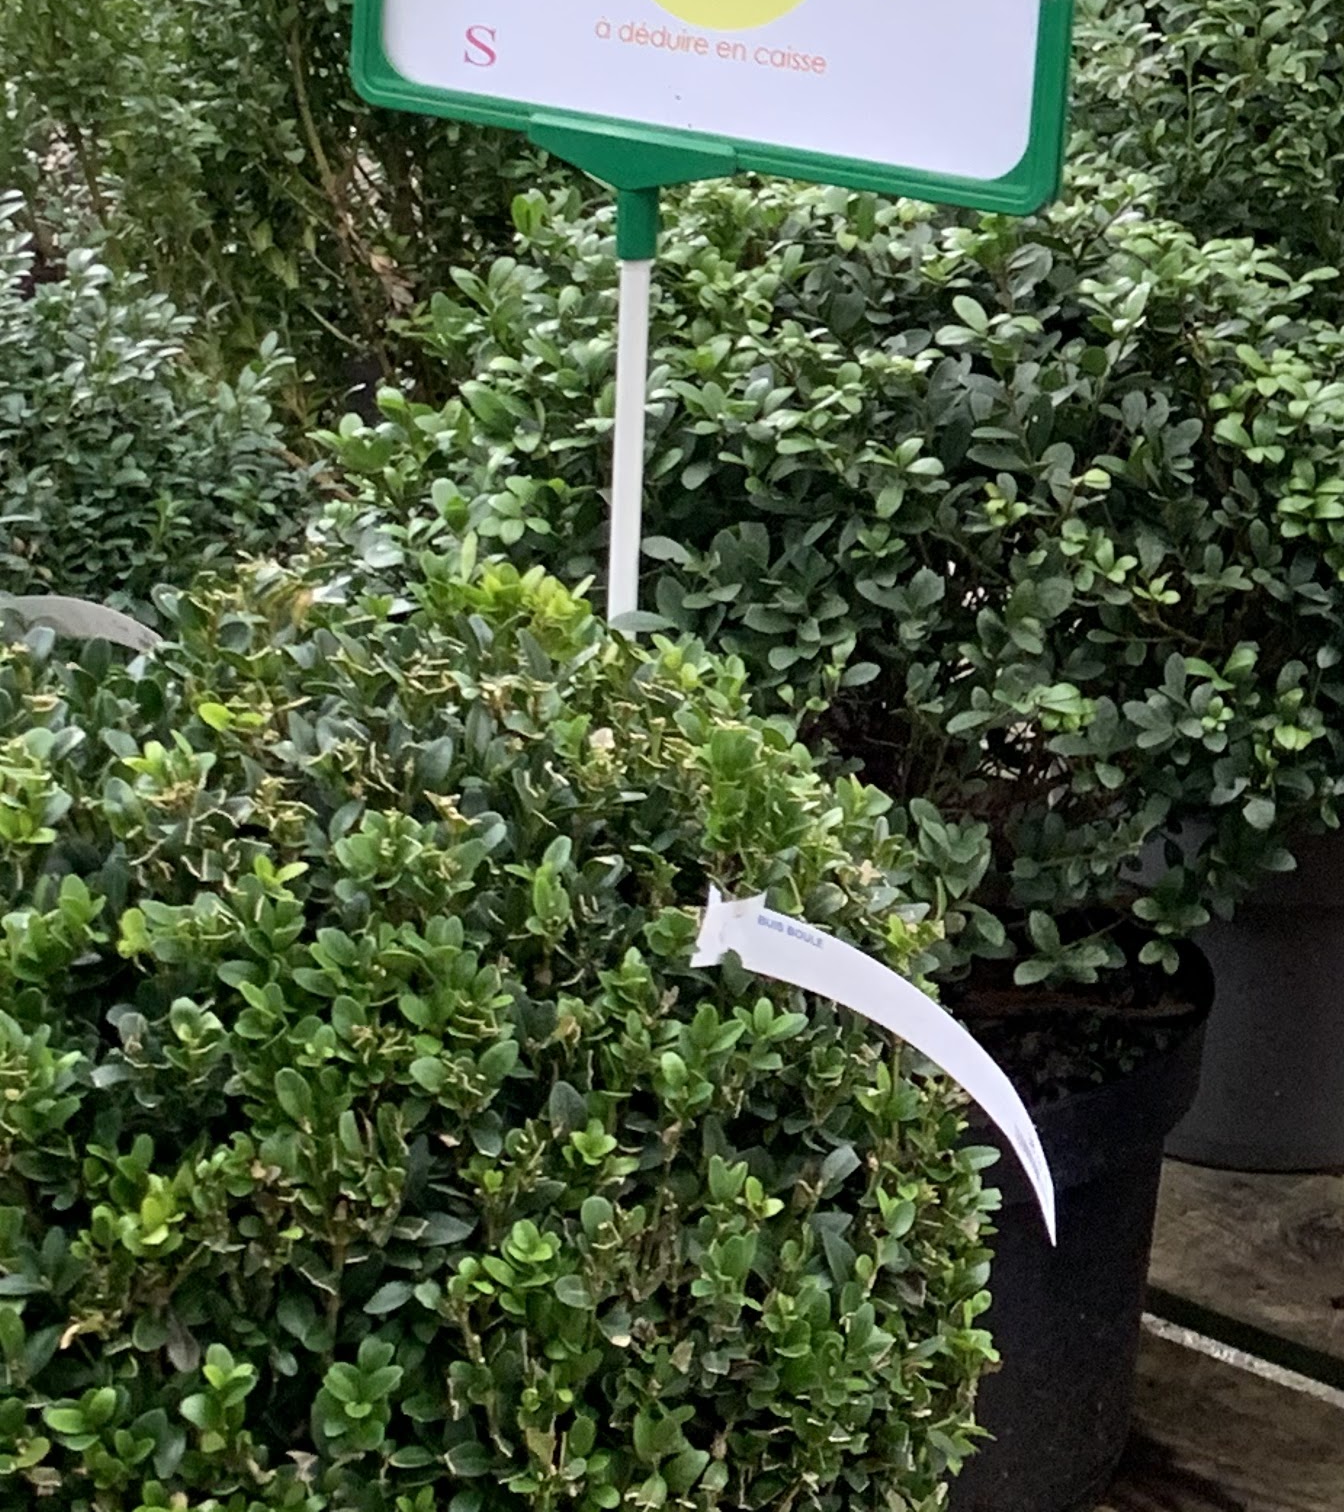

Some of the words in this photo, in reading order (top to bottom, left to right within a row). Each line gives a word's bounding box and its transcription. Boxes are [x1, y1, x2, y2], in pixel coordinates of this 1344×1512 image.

[595, 16, 611, 39] à
[618, 21, 709, 56] déduire
[716, 40, 747, 61] en
[754, 45, 827, 74] caisse
